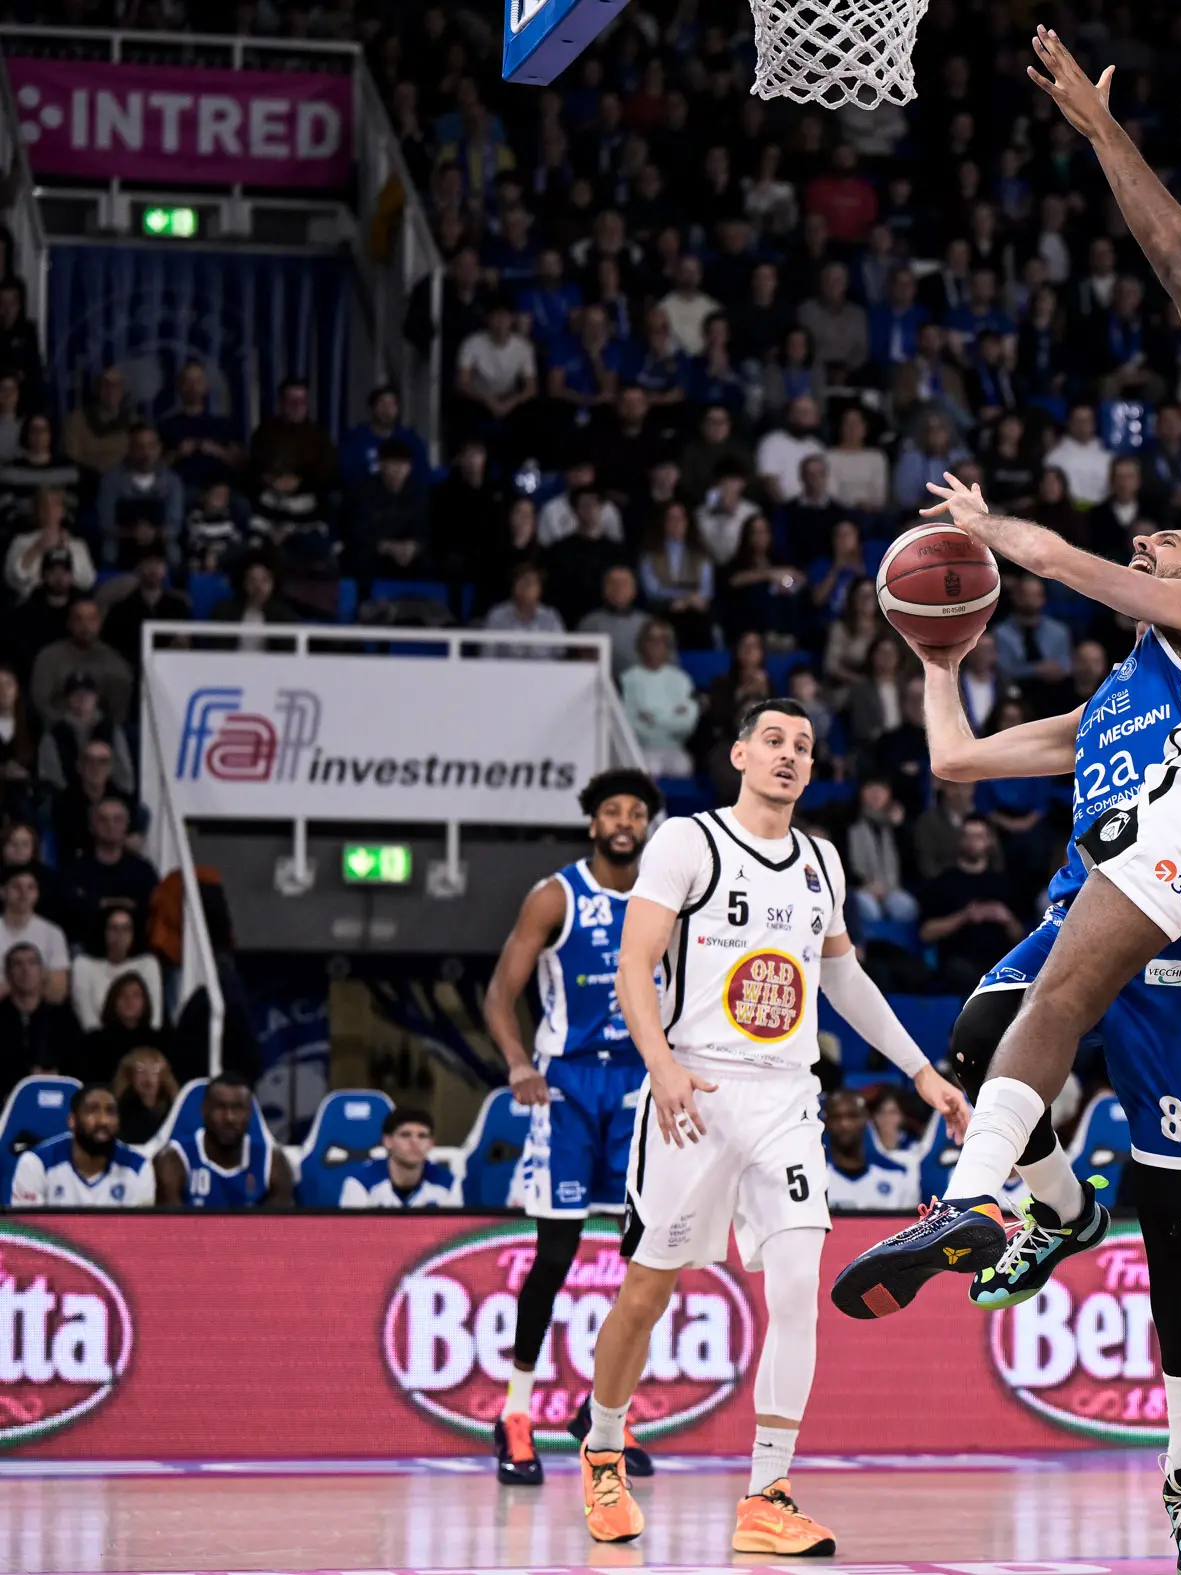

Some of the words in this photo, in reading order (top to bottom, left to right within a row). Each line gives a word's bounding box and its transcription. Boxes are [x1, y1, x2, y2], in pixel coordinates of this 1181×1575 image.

[71, 88, 341, 160] INTRED
[1099, 704, 1171, 749] MEGRANI
[308, 748, 577, 791] investments
[1086, 784, 1141, 815] COMPANY
[578, 894, 613, 928] 23
[728, 890, 749, 927] 5
[767, 907, 793, 923] SKY
[706, 936, 748, 948] SYNERGIE
[751, 959, 794, 986] OLD
[1148, 967, 1181, 978] VECCHI
[741, 979, 796, 1010] WILD
[735, 1001, 797, 1031] WEST
[785, 1163, 810, 1202] 5
